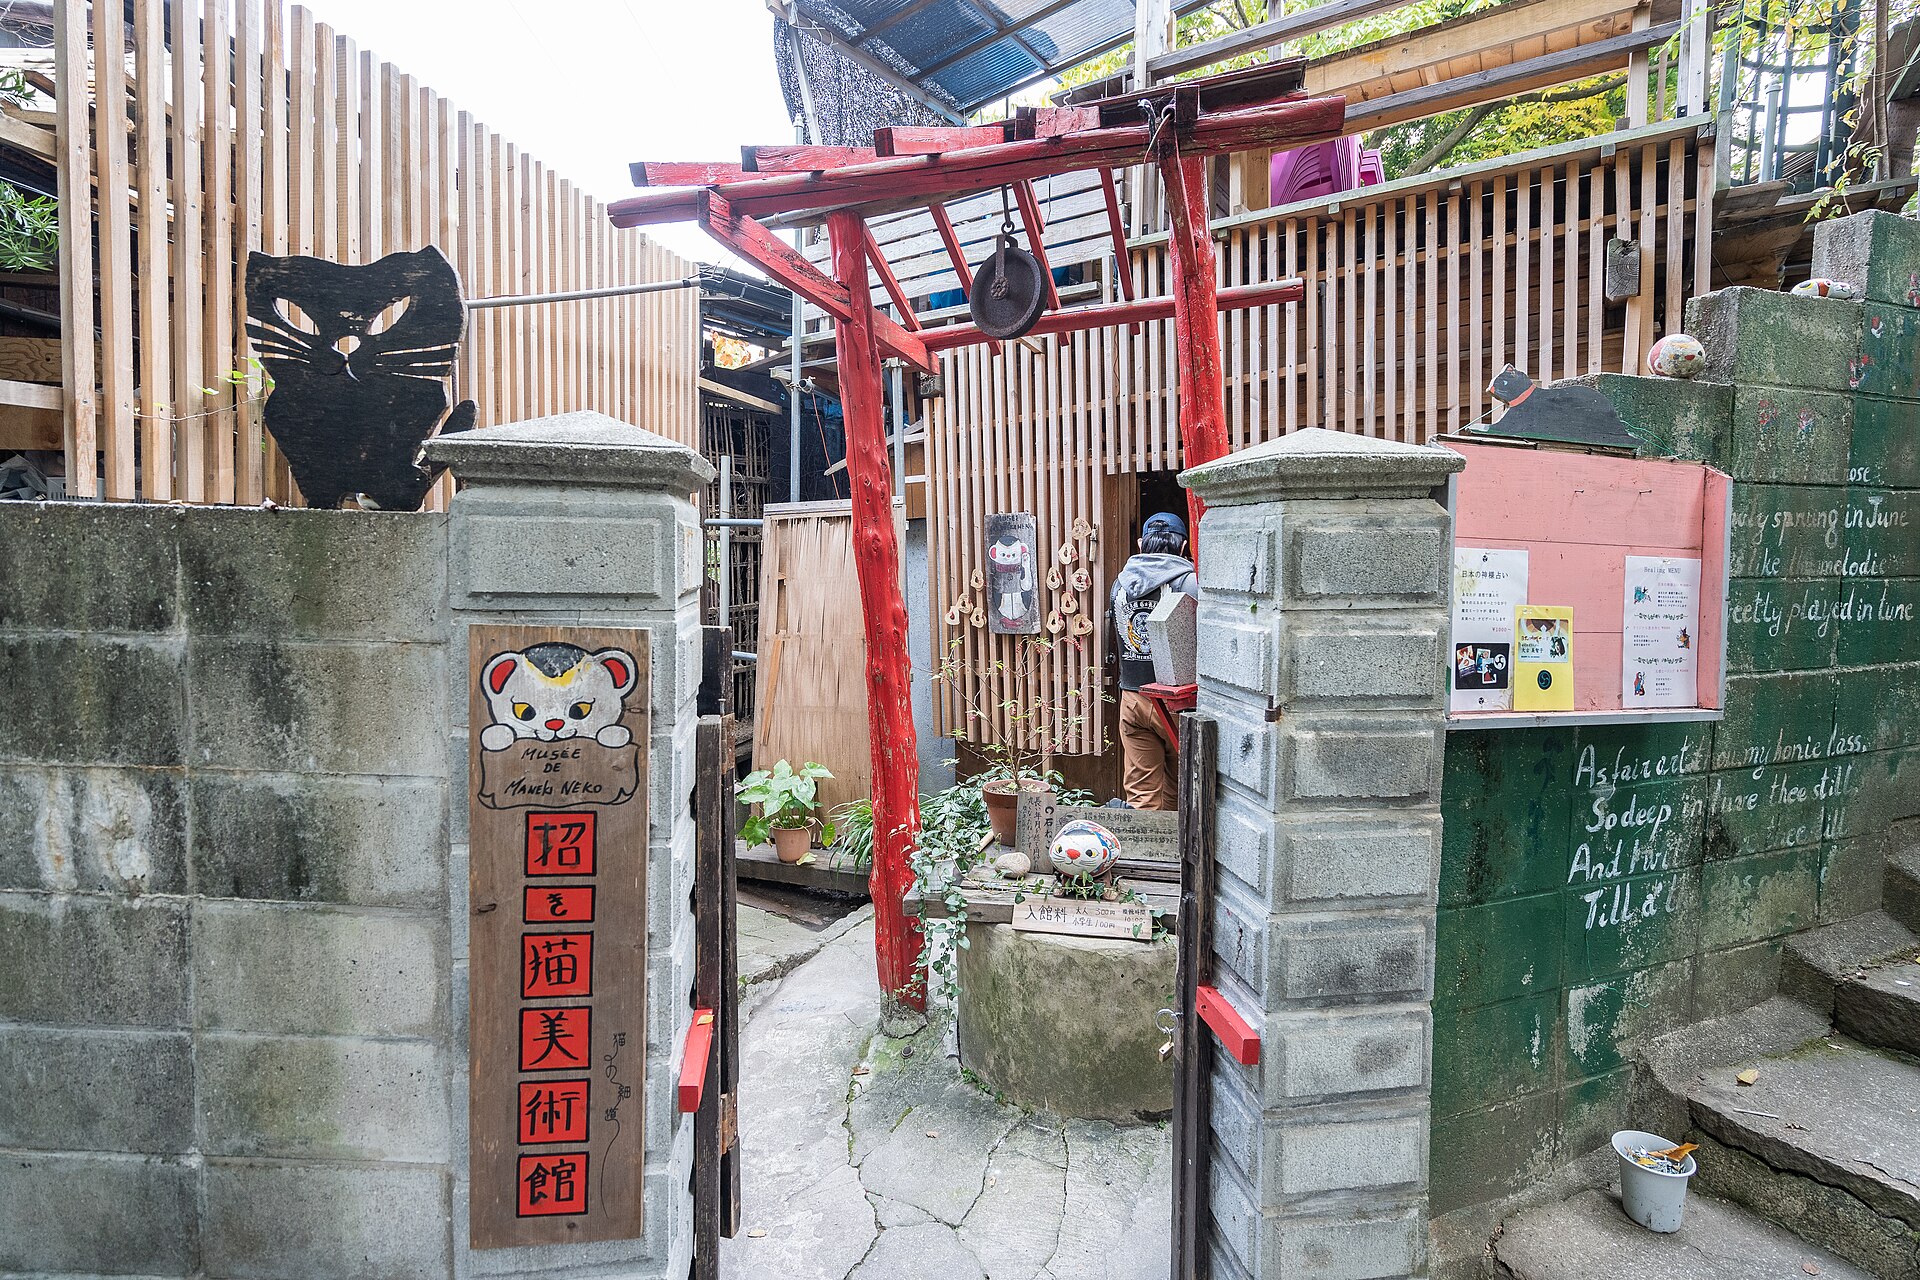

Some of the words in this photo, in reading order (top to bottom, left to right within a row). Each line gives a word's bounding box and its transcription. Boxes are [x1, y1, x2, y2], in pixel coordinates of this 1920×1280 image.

[1772, 508, 1839, 549] sprung
[1845, 503, 1863, 529] in
[1866, 496, 1910, 529] June
[1462, 570, 1509, 580] 日本の神様占い
[1785, 588, 1853, 637] played
[1856, 598, 1873, 622] in
[1878, 588, 1915, 622] tune
[543, 762, 561, 773] DE
[561, 780, 603, 795] NEKO
[1575, 744, 1607, 788] As
[1605, 746, 1651, 801] fair
[1656, 735, 1689, 776] art
[1586, 797, 1618, 833] So
[1621, 793, 1672, 842] deep
[1770, 773, 1808, 805] thee
[1567, 839, 1622, 884] And
[1024, 904, 1068, 923] 入館料
[1075, 906, 1089, 916] 大人
[1072, 916, 1093, 927] 小学生
[1583, 882, 1633, 930] Till
[524, 821, 586, 1206] 招き猫美術館
